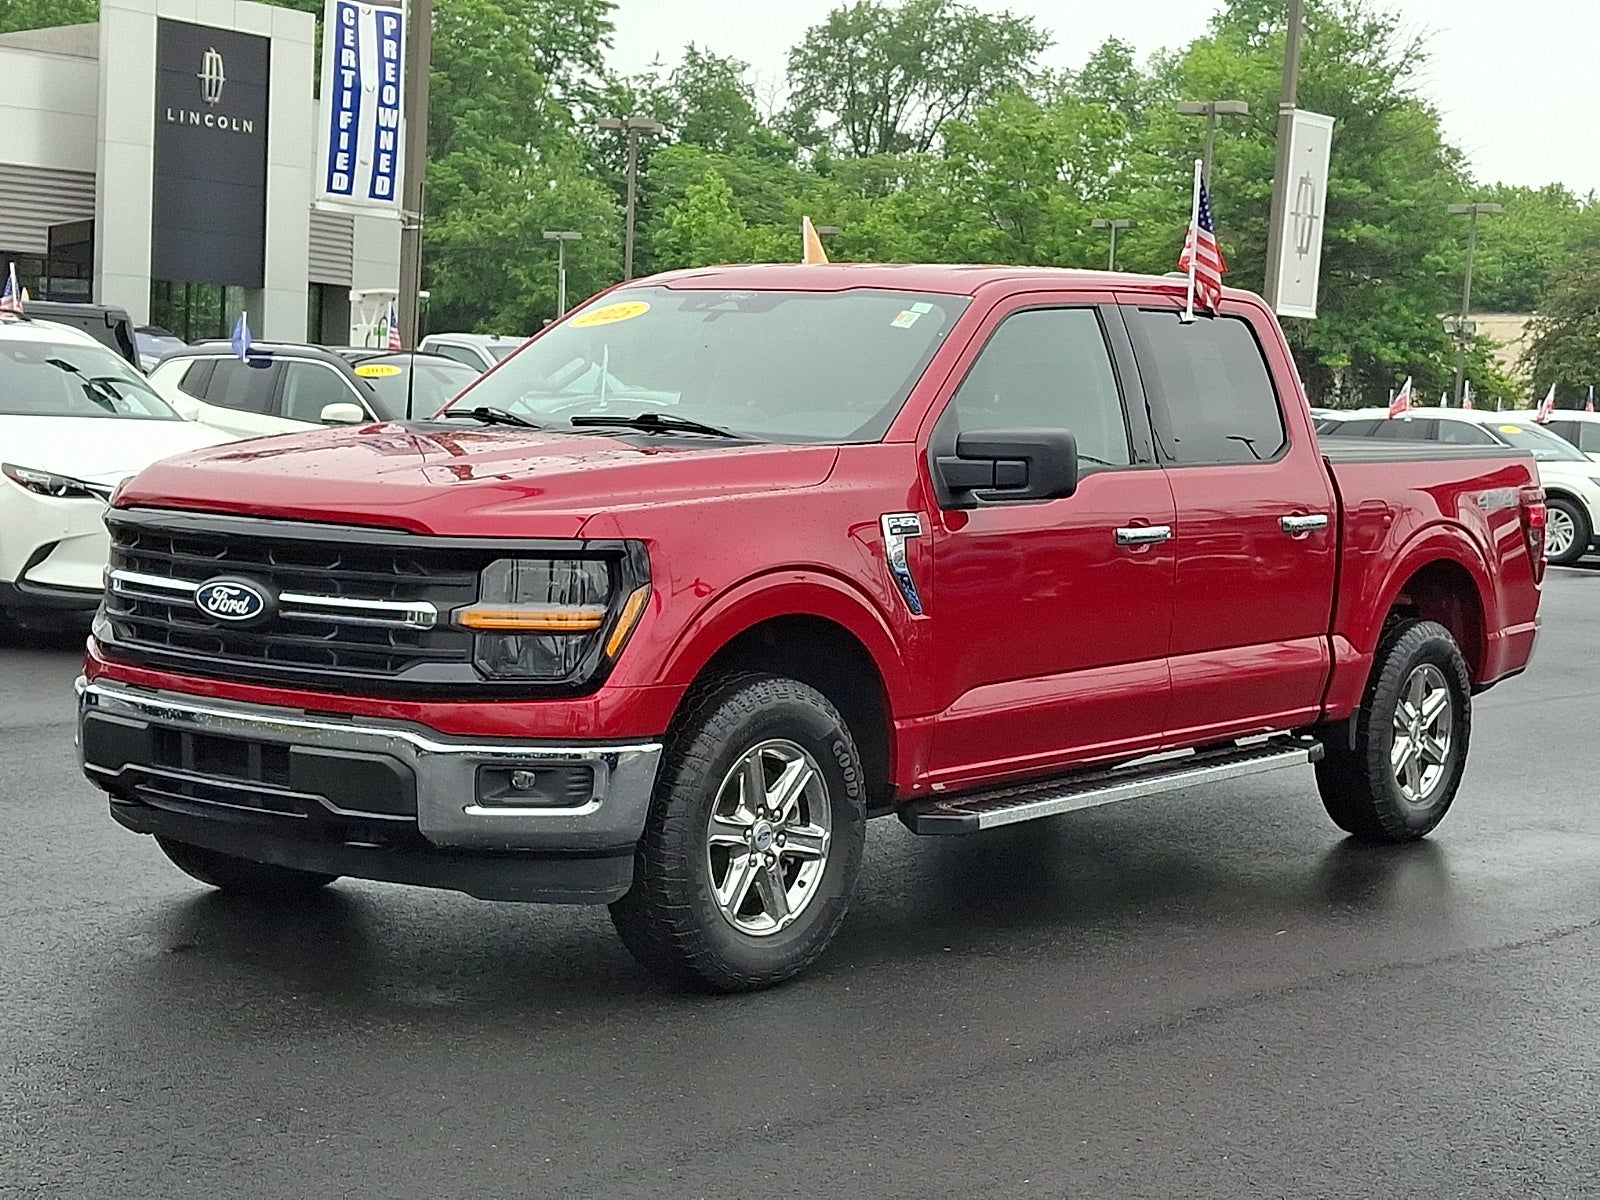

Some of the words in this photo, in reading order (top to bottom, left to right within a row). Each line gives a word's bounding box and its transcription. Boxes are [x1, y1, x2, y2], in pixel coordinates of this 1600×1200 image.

[167, 107, 253, 134] LINCOLN
[331, 7, 356, 191] CERTIFIED
[375, 15, 398, 196] PREOWNED
[207, 586, 251, 615] Ford
